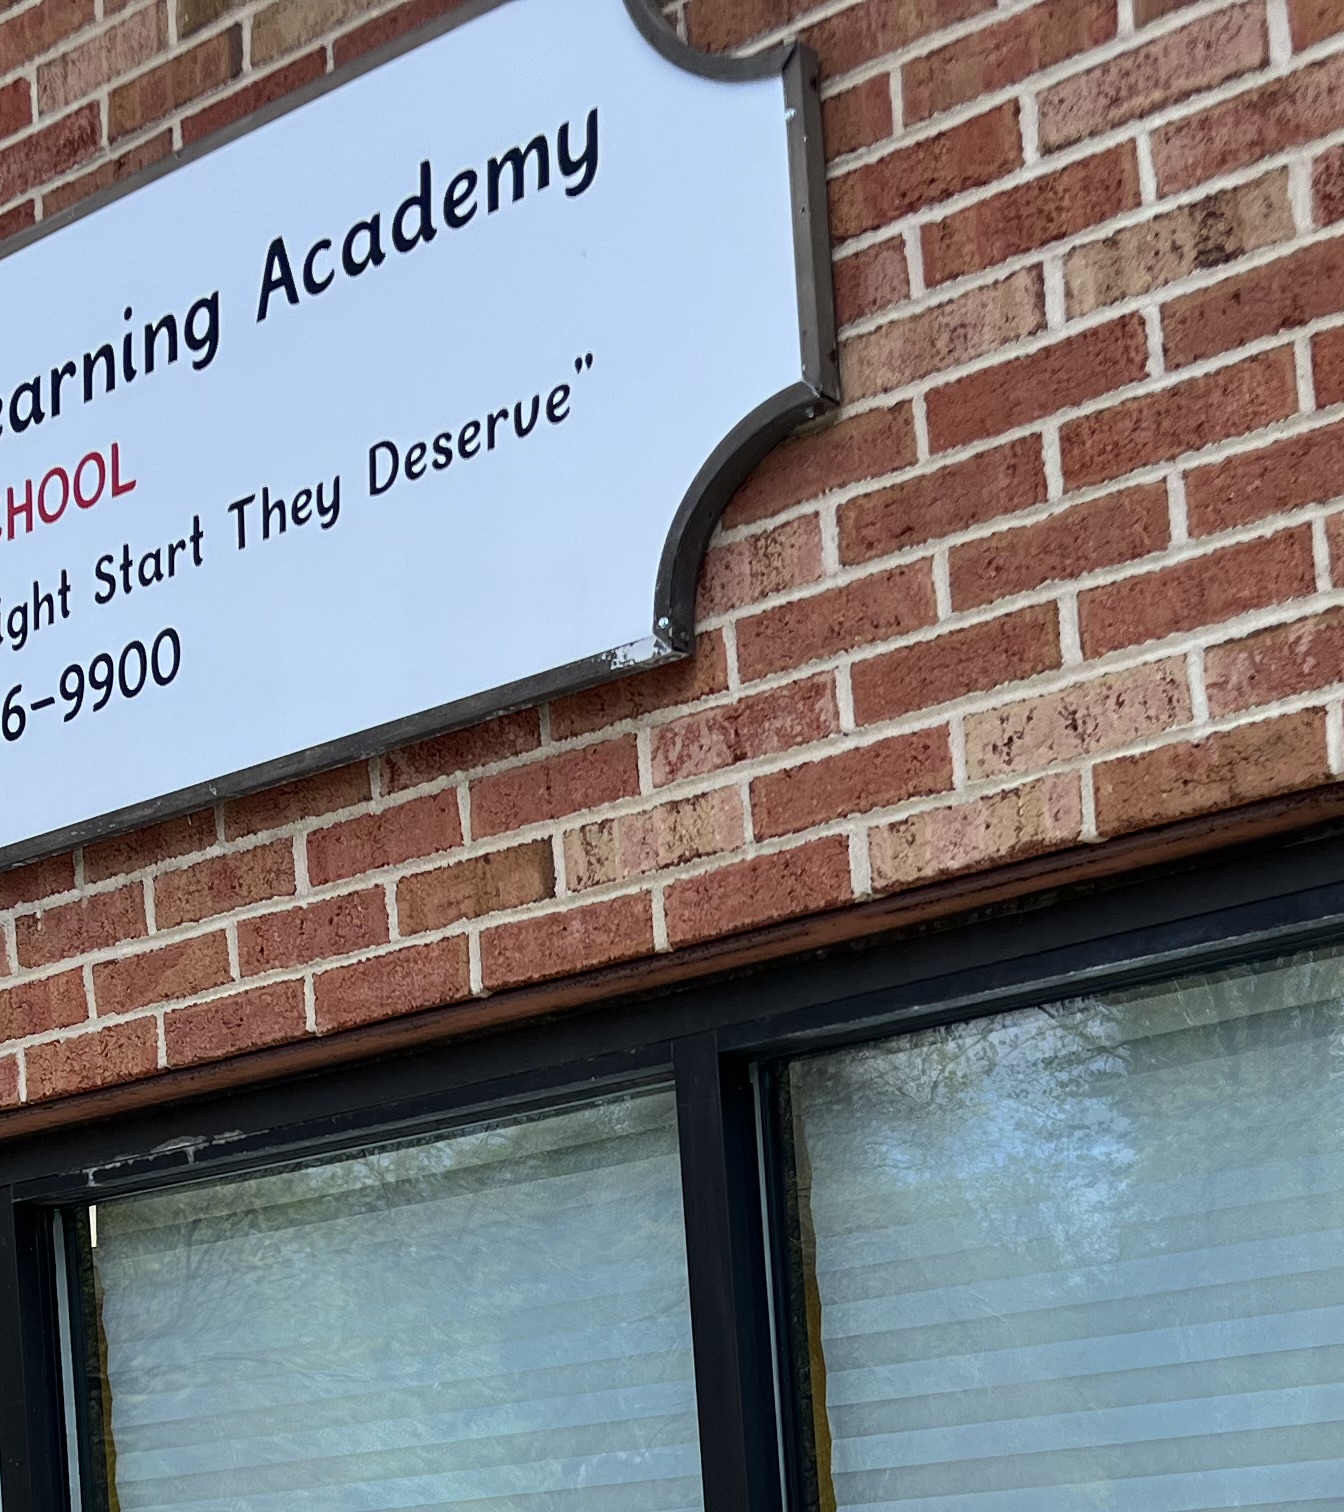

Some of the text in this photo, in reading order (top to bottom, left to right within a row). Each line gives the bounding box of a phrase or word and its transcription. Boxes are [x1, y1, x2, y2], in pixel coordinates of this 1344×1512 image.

[256, 106, 600, 324] Academy
[94, 515, 205, 605] Start
[227, 475, 342, 550] They
[368, 352, 595, 497] Deserve"
